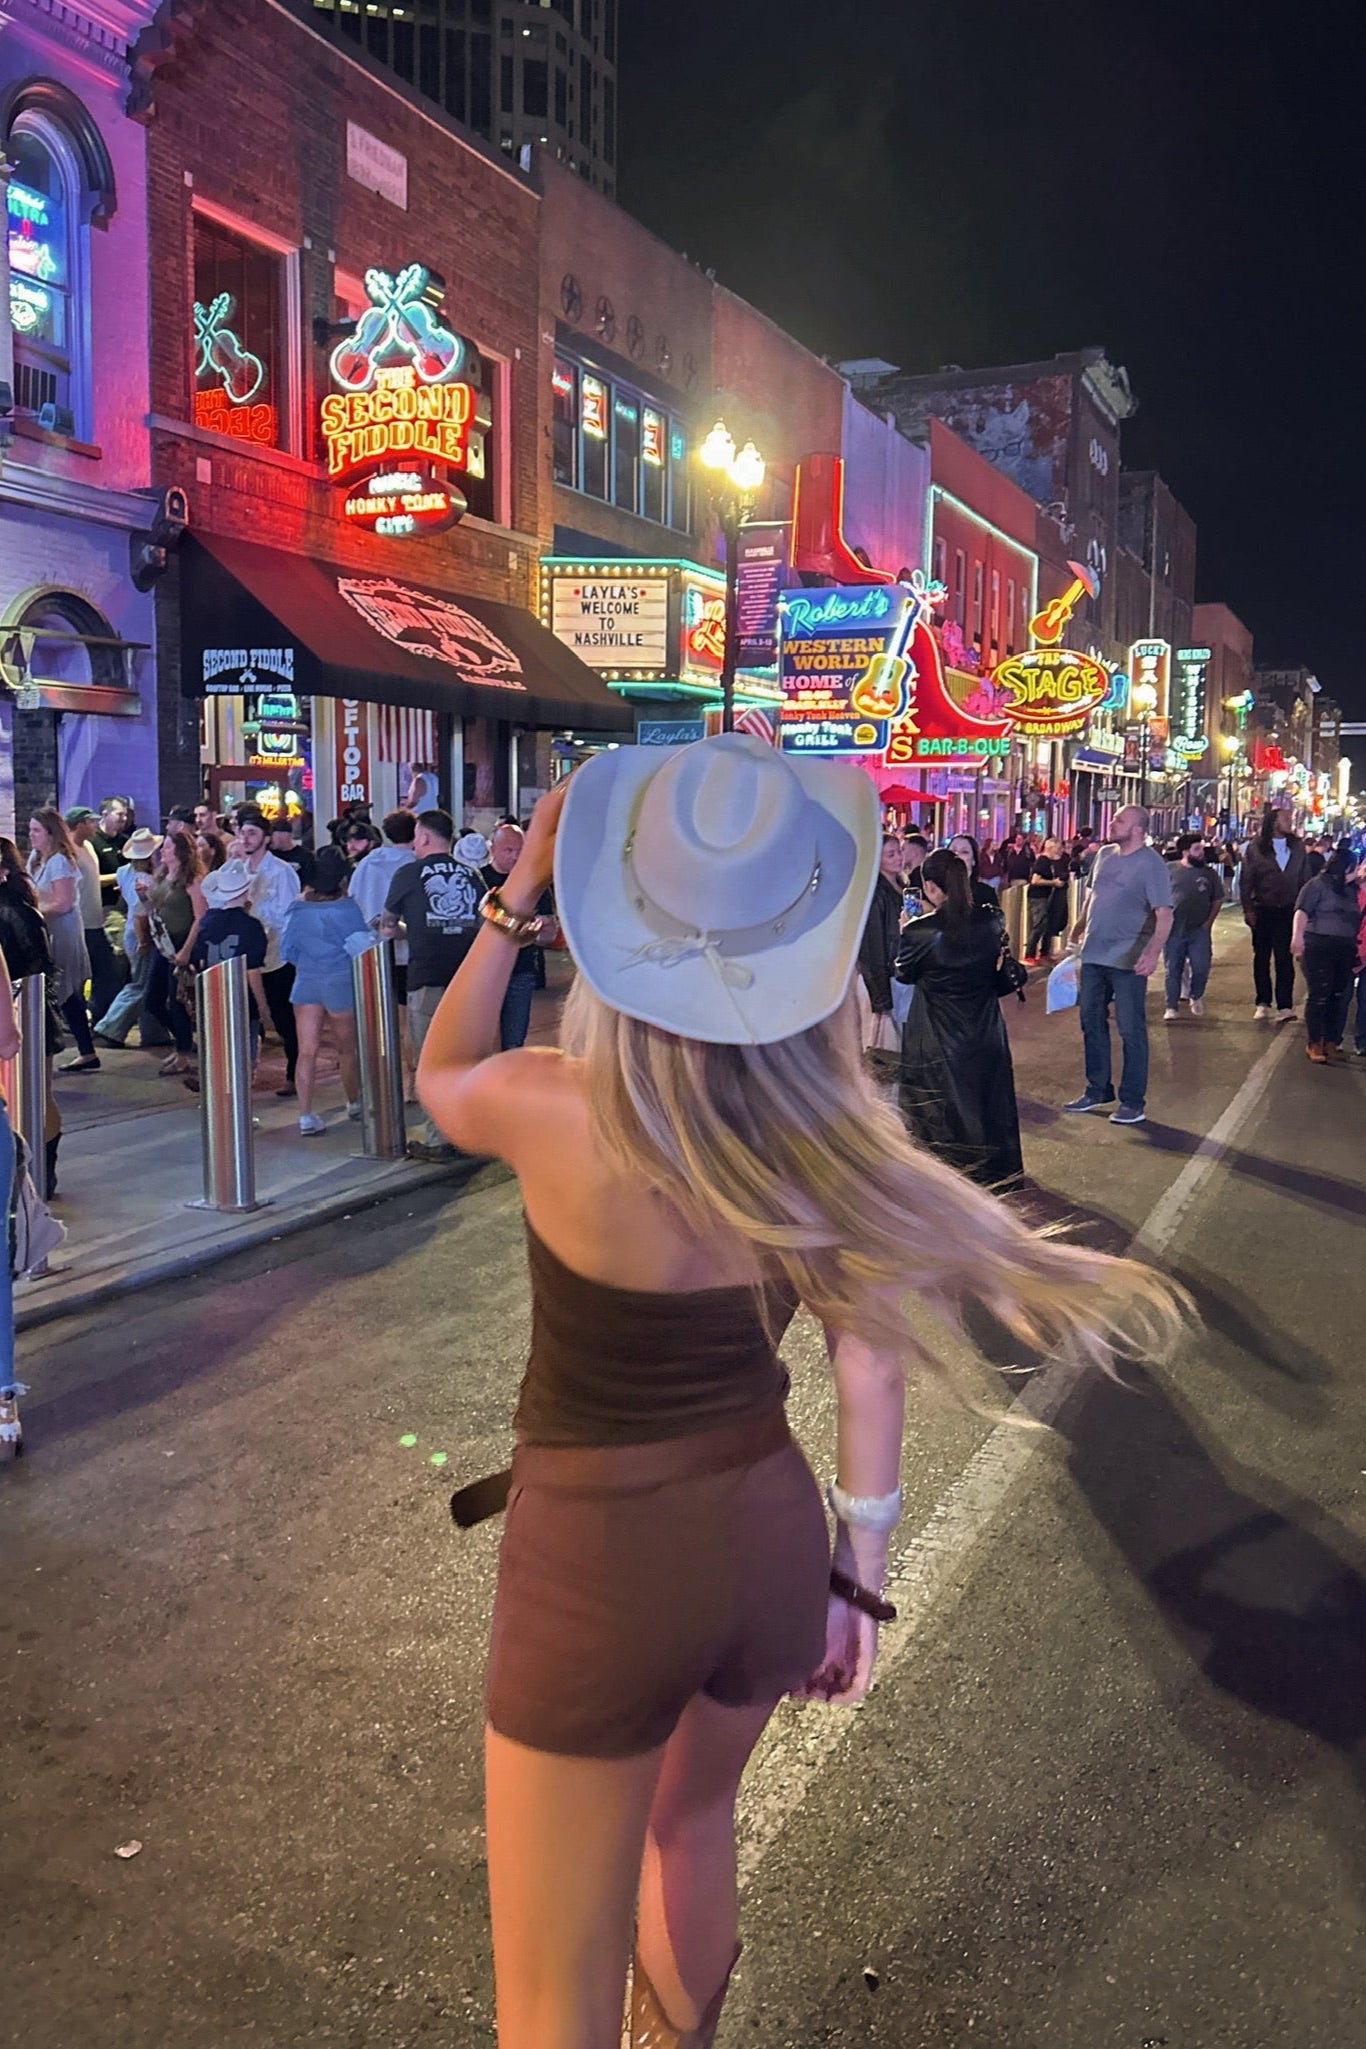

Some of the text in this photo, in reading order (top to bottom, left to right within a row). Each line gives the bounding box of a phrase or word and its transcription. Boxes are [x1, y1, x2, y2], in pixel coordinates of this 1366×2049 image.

[374, 366, 416, 389] THE
[321, 383, 469, 435] SECOND
[329, 421, 462, 474] FIDDLE
[345, 493, 447, 515] HONKY TONK
[582, 586, 638, 599] LAYLA'S
[581, 602, 640, 614] WELCOME
[788, 589, 889, 638] Robert's
[599, 617, 615, 630] TO
[575, 633, 643, 646] NASHVILLE
[783, 637, 885, 654] WESTERN
[1038, 652, 1060, 665] THE
[1134, 645, 1166, 657] LUCKY
[203, 649, 294, 682] SECOND FIDDLE
[793, 653, 870, 670] WORLD
[782, 672, 859, 692] HOME of
[998, 662, 1103, 707] STAGE
[1025, 717, 1086, 734] BROADWAY
[642, 728, 699, 745] Layla's
[795, 735, 838, 746] GRILL
[918, 737, 1011, 756] BAR-B-QUE
[341, 784, 365, 801] BAR
[421, 862, 474, 878] ARIAT
